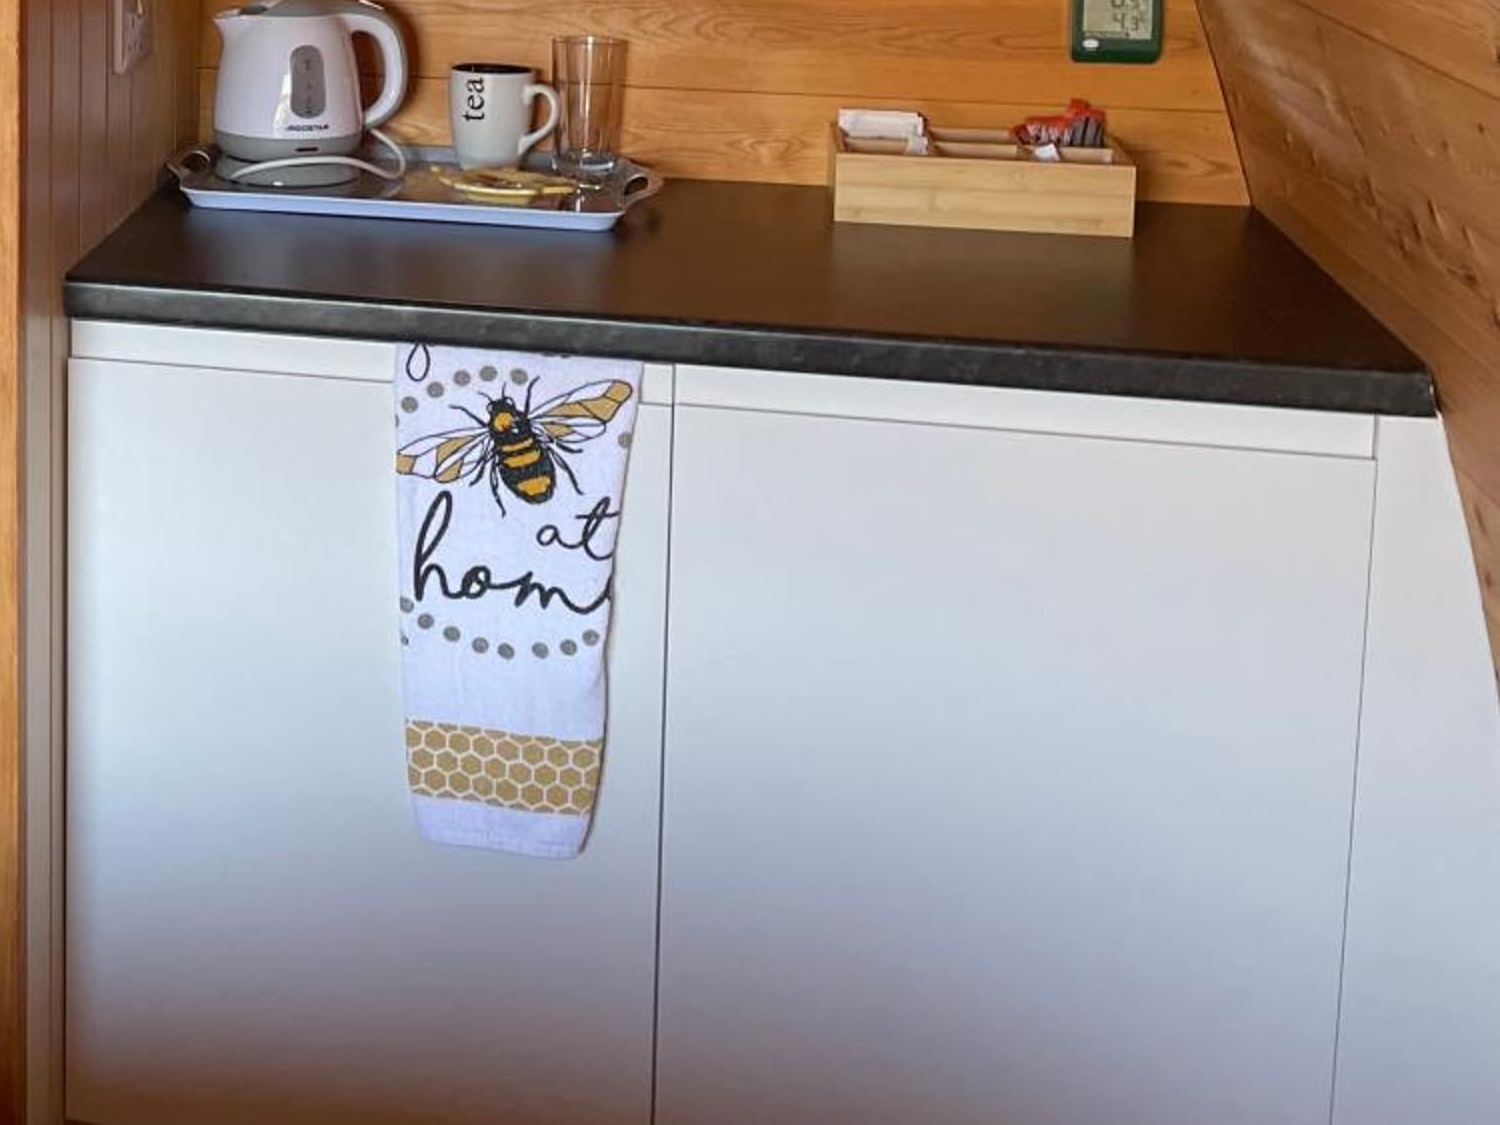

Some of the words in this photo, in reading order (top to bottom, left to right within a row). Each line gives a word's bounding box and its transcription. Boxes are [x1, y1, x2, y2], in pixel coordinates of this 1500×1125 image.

[461, 77, 485, 122] tea
[413, 490, 614, 615] hom
[536, 496, 620, 561] at
